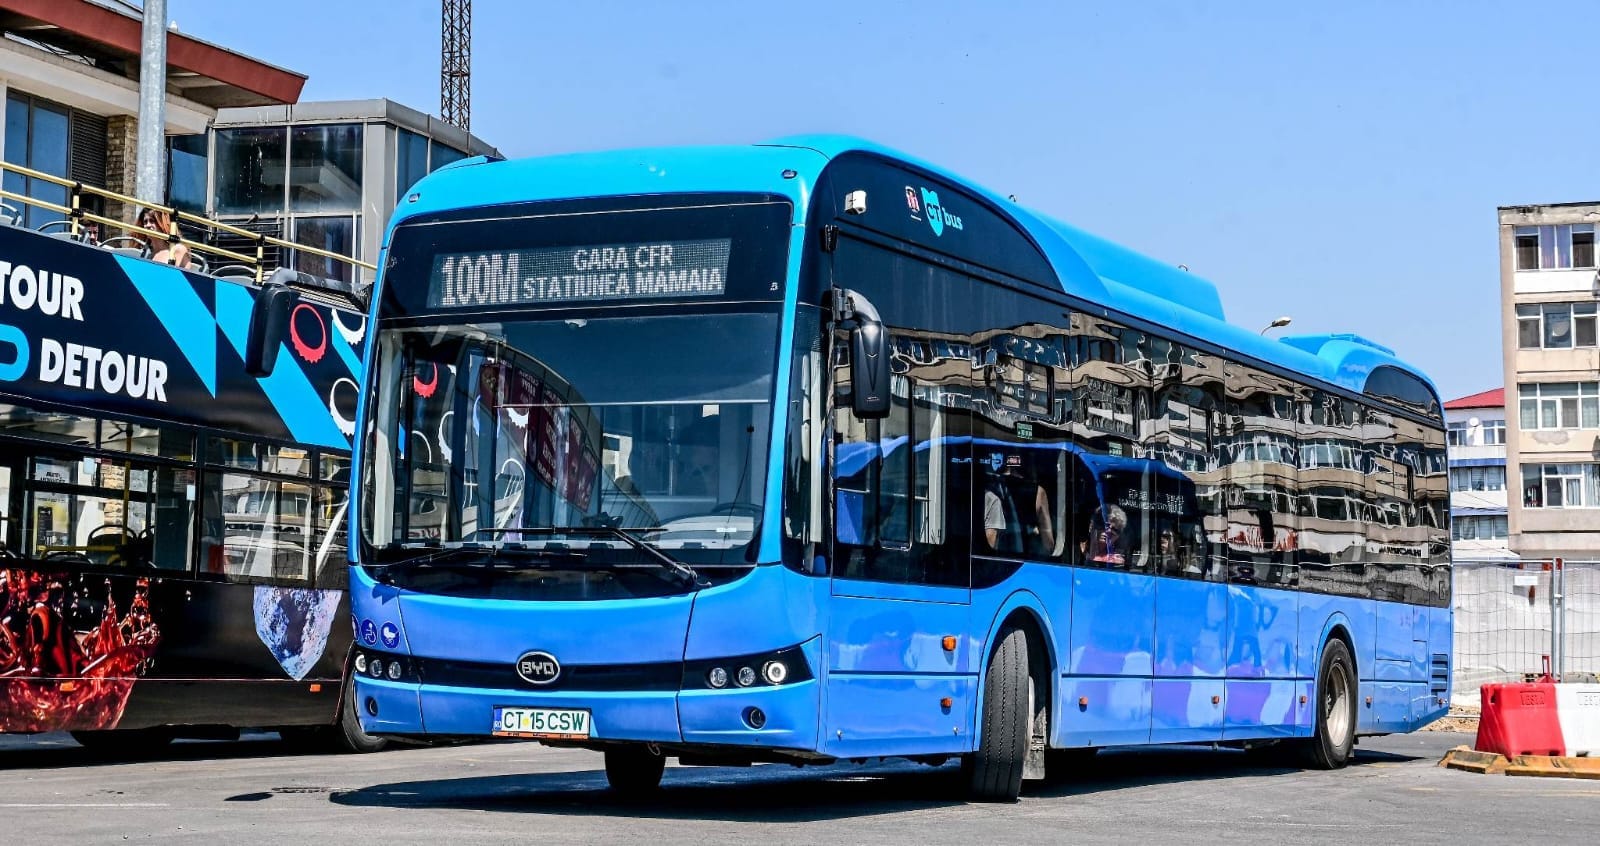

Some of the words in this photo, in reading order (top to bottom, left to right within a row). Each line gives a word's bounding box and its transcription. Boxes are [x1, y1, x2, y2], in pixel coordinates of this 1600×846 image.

[926, 203, 940, 222] CT
[942, 206, 963, 230] bus
[573, 247, 629, 271] GARA
[635, 245, 673, 268] CFR
[442, 253, 519, 305] 100M
[523, 272, 630, 299] STATIUNEA
[635, 268, 722, 294] MAMAIA
[40, 337, 168, 402] DETOUR
[521, 661, 555, 675] BYD
[504, 711, 524, 730] CT
[529, 711, 545, 730] 15
[547, 712, 585, 731] CSW
